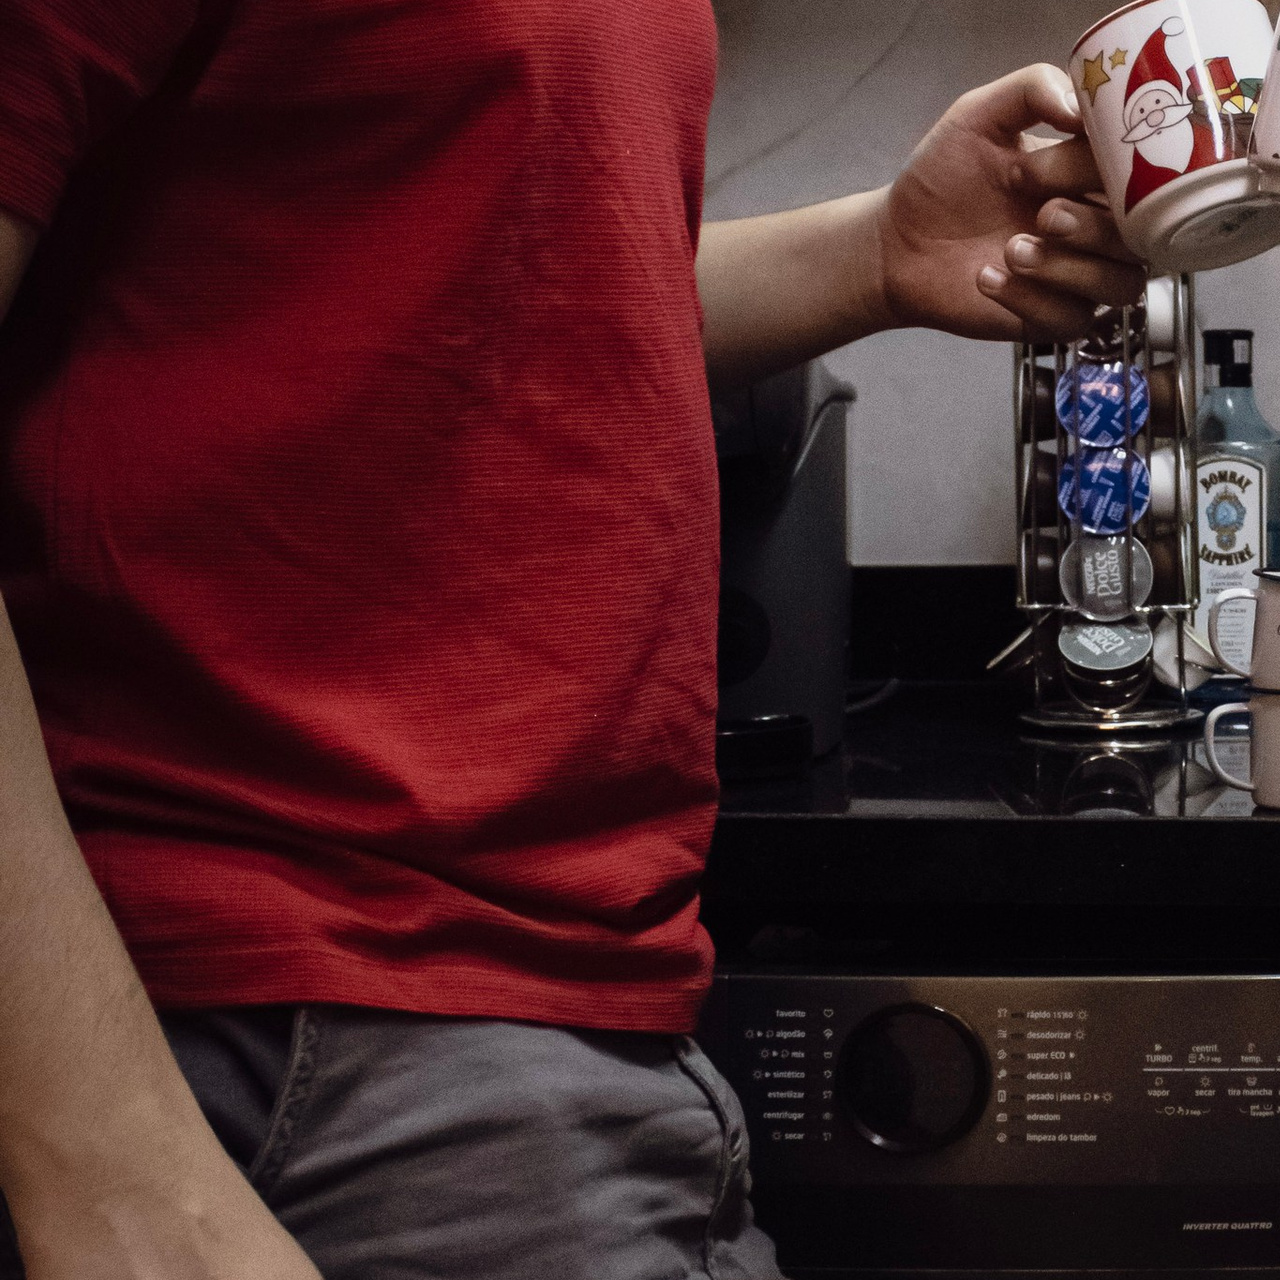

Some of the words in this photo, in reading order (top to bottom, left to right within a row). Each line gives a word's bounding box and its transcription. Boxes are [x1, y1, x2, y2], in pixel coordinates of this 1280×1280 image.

[1200, 470, 1252, 494] BOMBAY
[1199, 543, 1256, 566] SAPPHIRE
[776, 1009, 806, 1018] favorito
[1026, 1031, 1072, 1040] desodorizar
[1026, 1052, 1049, 1060] super
[1050, 1051, 1067, 1060] ECO
[1145, 1054, 1173, 1063] TURBO
[1026, 1072, 1060, 1080] delicado
[1026, 1093, 1055, 1102] pesado
[1147, 1089, 1171, 1098] vapor
[1195, 1089, 1216, 1097] secar
[1026, 1113, 1061, 1121] edredom
[1026, 1133, 1057, 1142] limpeza
[1058, 1133, 1068, 1141] do
[1182, 1222, 1229, 1230] INVERTER
[1230, 1221, 1273, 1230] QUATTRO
